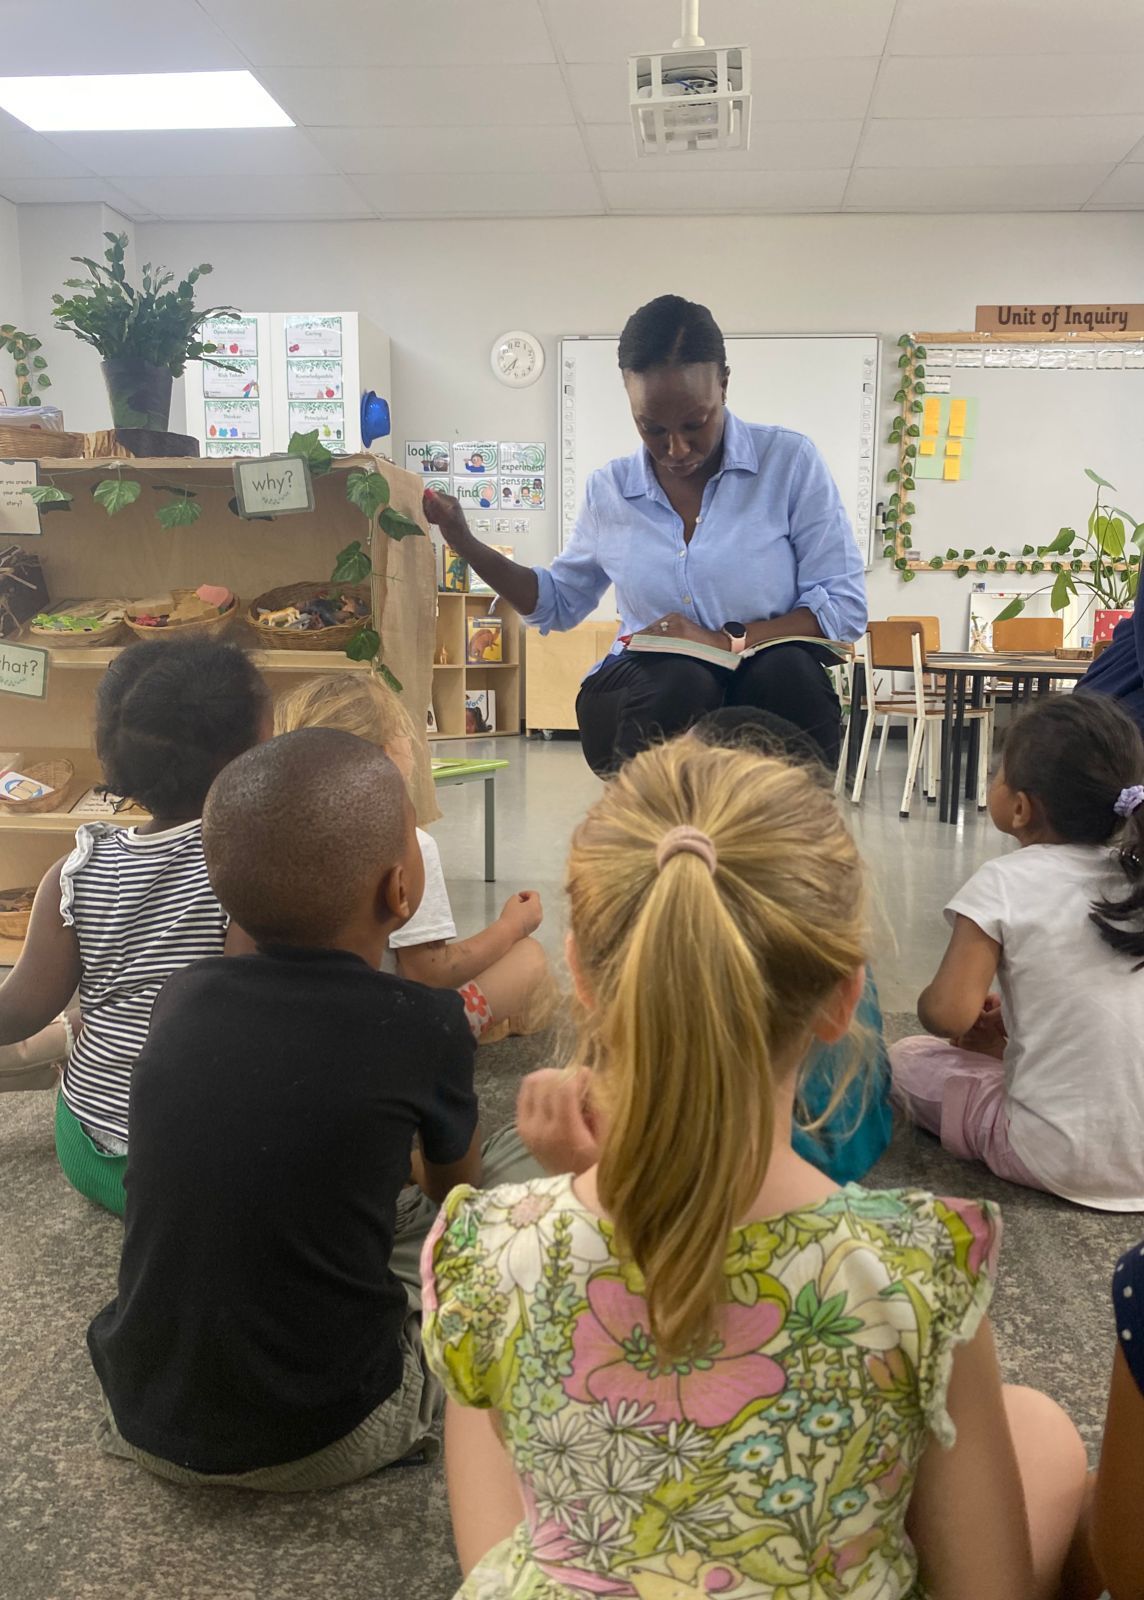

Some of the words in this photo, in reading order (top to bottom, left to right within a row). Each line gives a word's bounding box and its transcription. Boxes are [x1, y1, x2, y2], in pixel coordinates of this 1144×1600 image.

[998, 305, 1036, 325] Unit
[1041, 305, 1061, 332] of
[1064, 304, 1129, 332] Inquiry
[407, 444, 432, 456] look
[501, 463, 545, 473] experiment
[252, 470, 293, 494] why?
[457, 485, 480, 499] find
[0, 654, 38, 676] hat?
